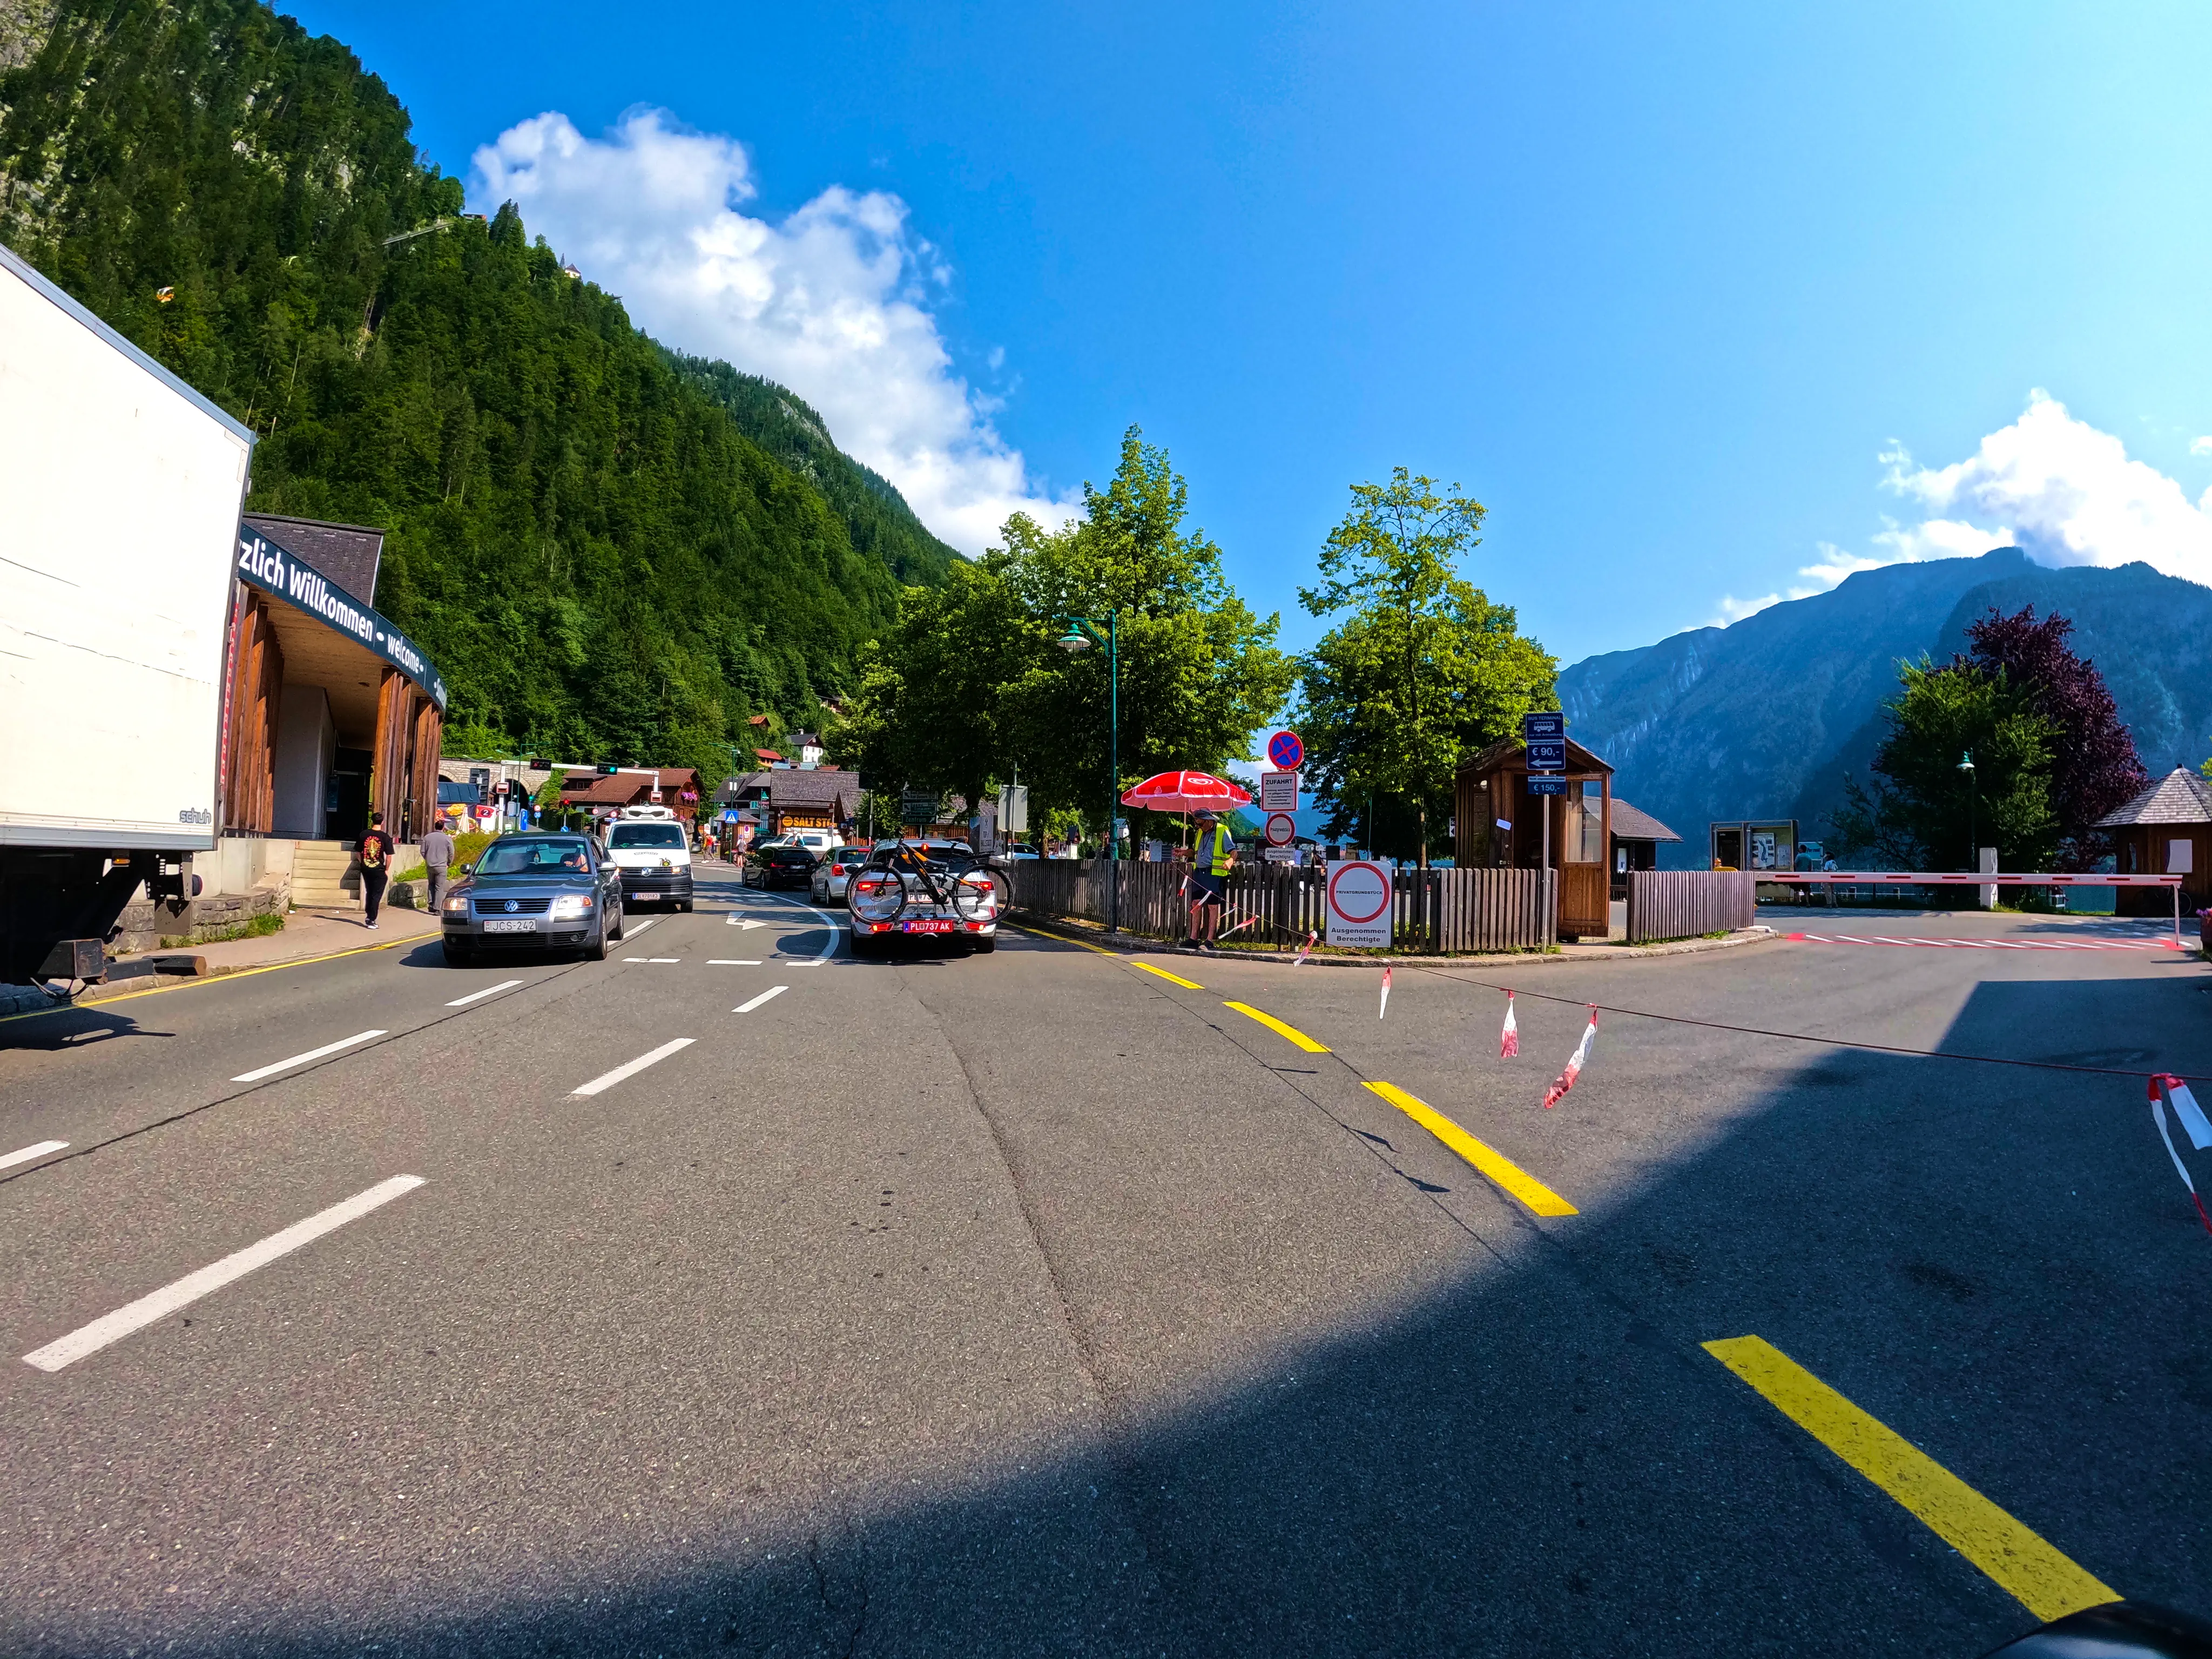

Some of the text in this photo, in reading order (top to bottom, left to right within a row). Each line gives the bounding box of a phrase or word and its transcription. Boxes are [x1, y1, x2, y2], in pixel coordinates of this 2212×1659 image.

[238, 538, 420, 674] zlich Willkommen welcome
[1532, 747, 1560, 757] € 90,-
[1541, 784, 1560, 792] 150,-
[179, 807, 211, 824] schuh
[794, 817, 815, 827] SALT
[493, 921, 534, 930] JCS-242
[925, 922, 939, 930] 737
